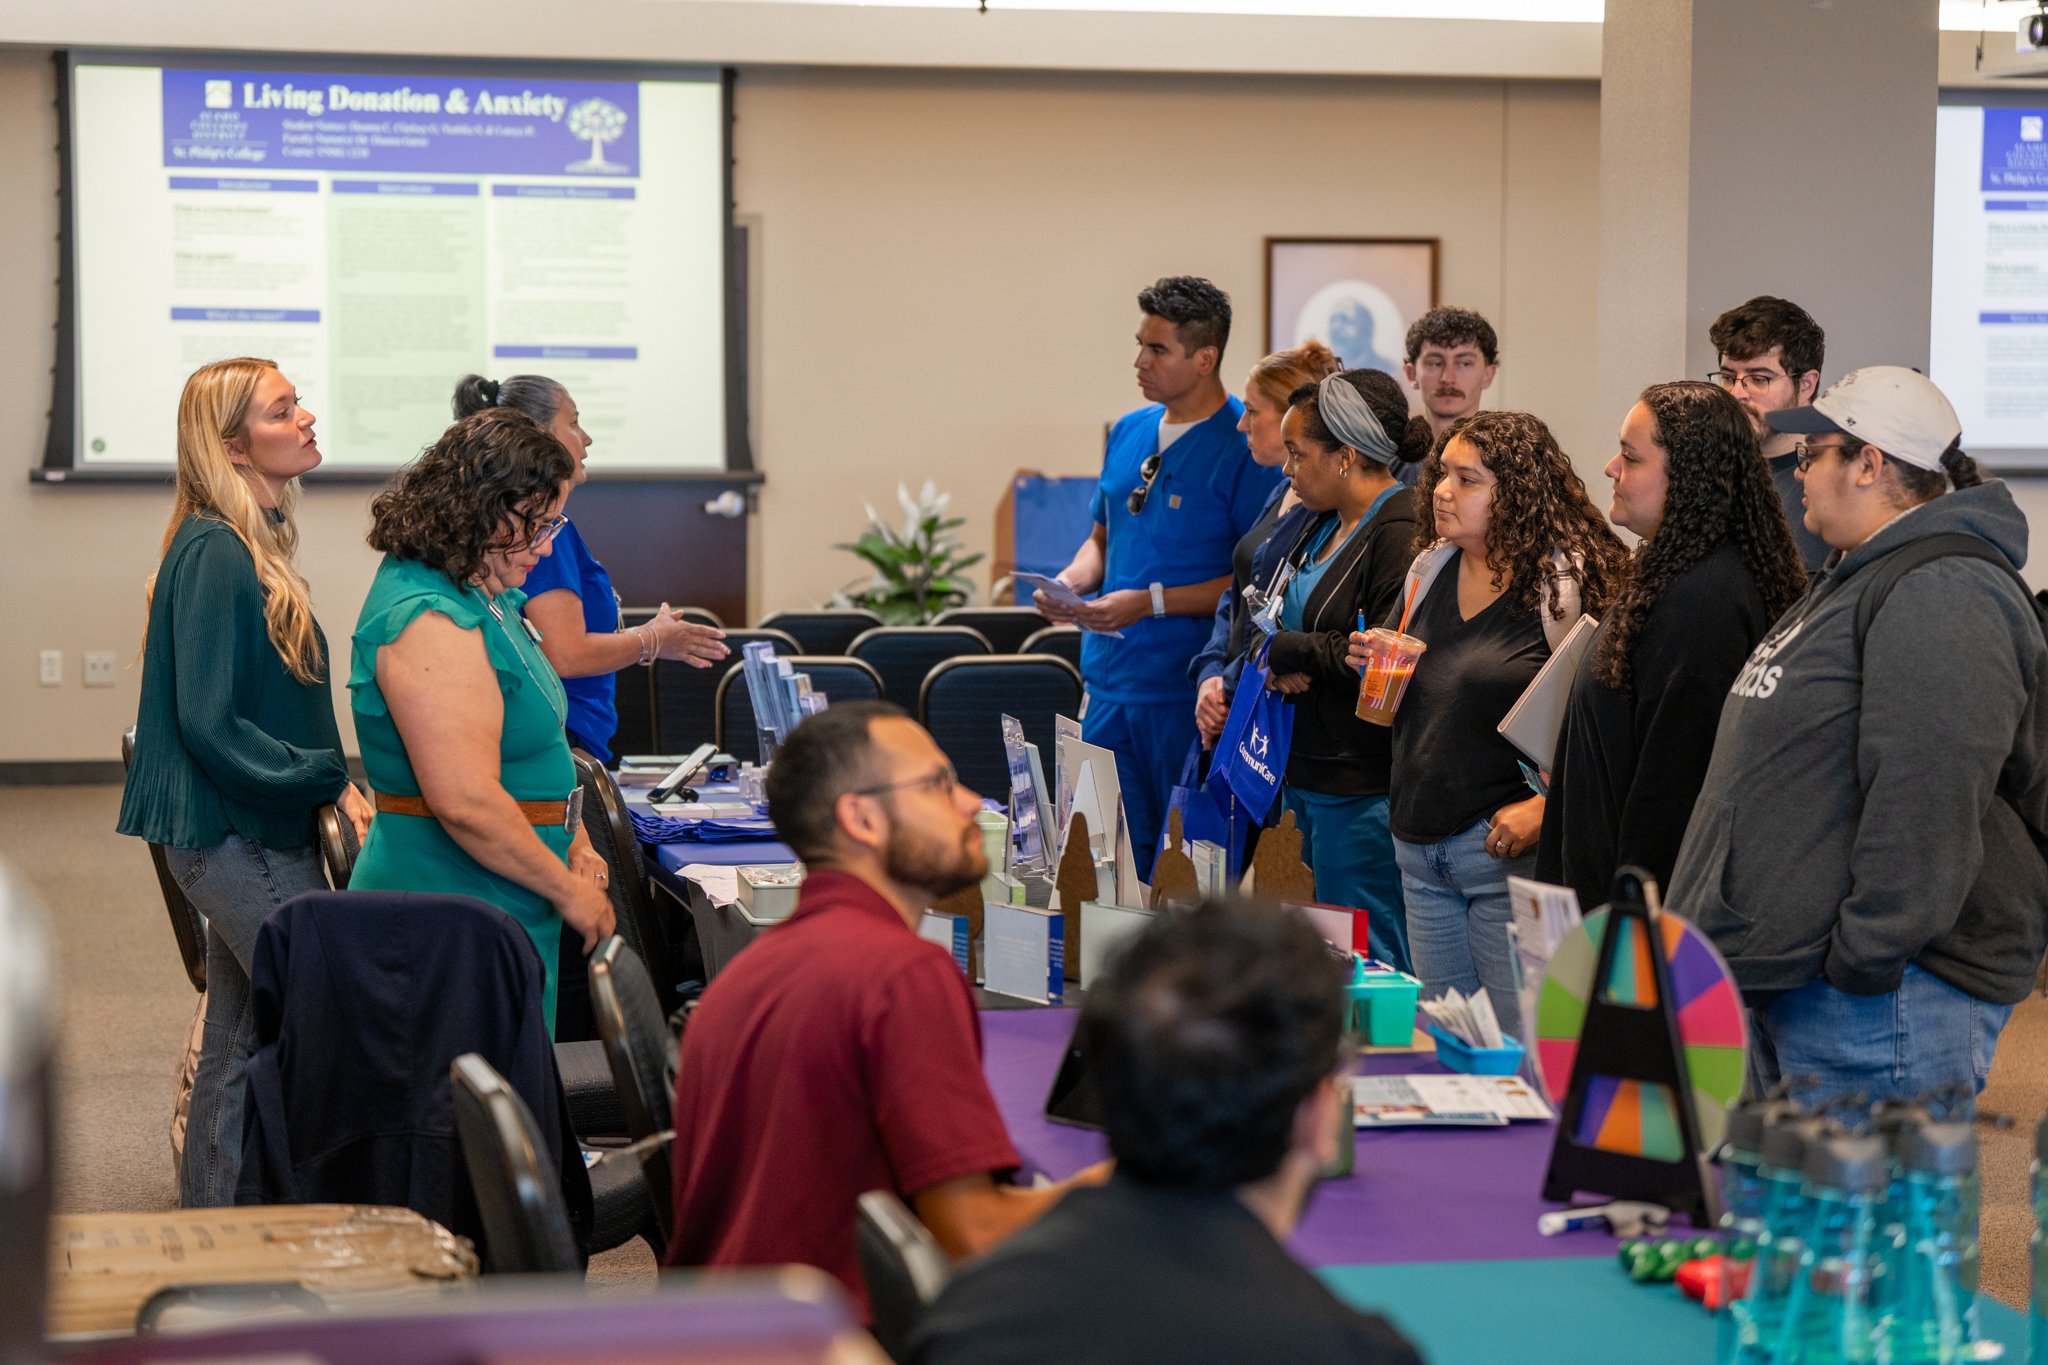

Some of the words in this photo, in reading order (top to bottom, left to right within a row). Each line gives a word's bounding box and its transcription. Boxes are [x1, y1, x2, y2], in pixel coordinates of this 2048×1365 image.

[244, 82, 324, 116] Living
[329, 84, 440, 113] Donation
[445, 87, 470, 114] &
[473, 89, 568, 123] Anxiety
[1239, 741, 1276, 786] CommuniCare
